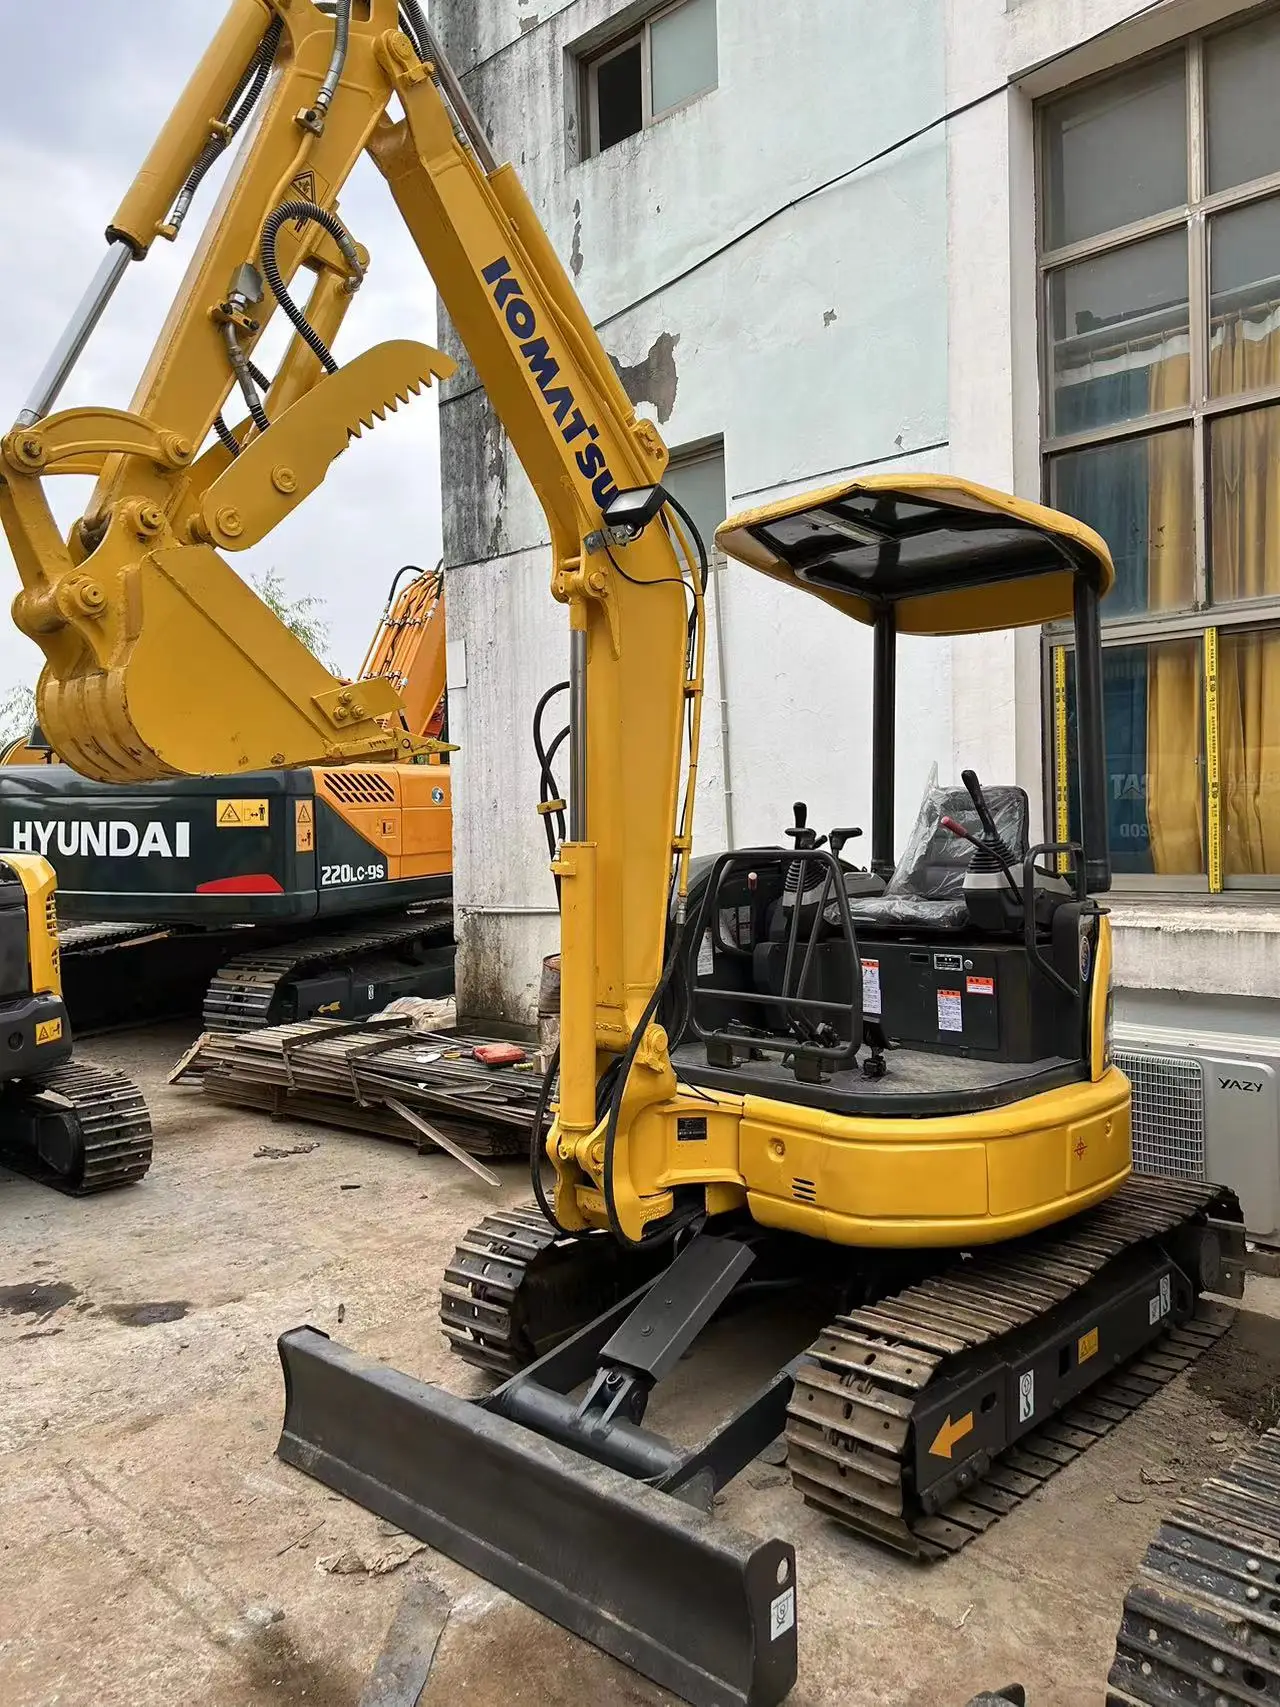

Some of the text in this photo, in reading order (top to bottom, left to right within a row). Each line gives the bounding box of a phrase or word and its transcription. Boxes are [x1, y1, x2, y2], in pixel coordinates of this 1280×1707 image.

[481, 256, 618, 508] KOMATSU
[13, 821, 190, 857] HYUNDAI
[321, 864, 384, 885] 220LC-9S
[1218, 1077, 1263, 1092] YAZY
